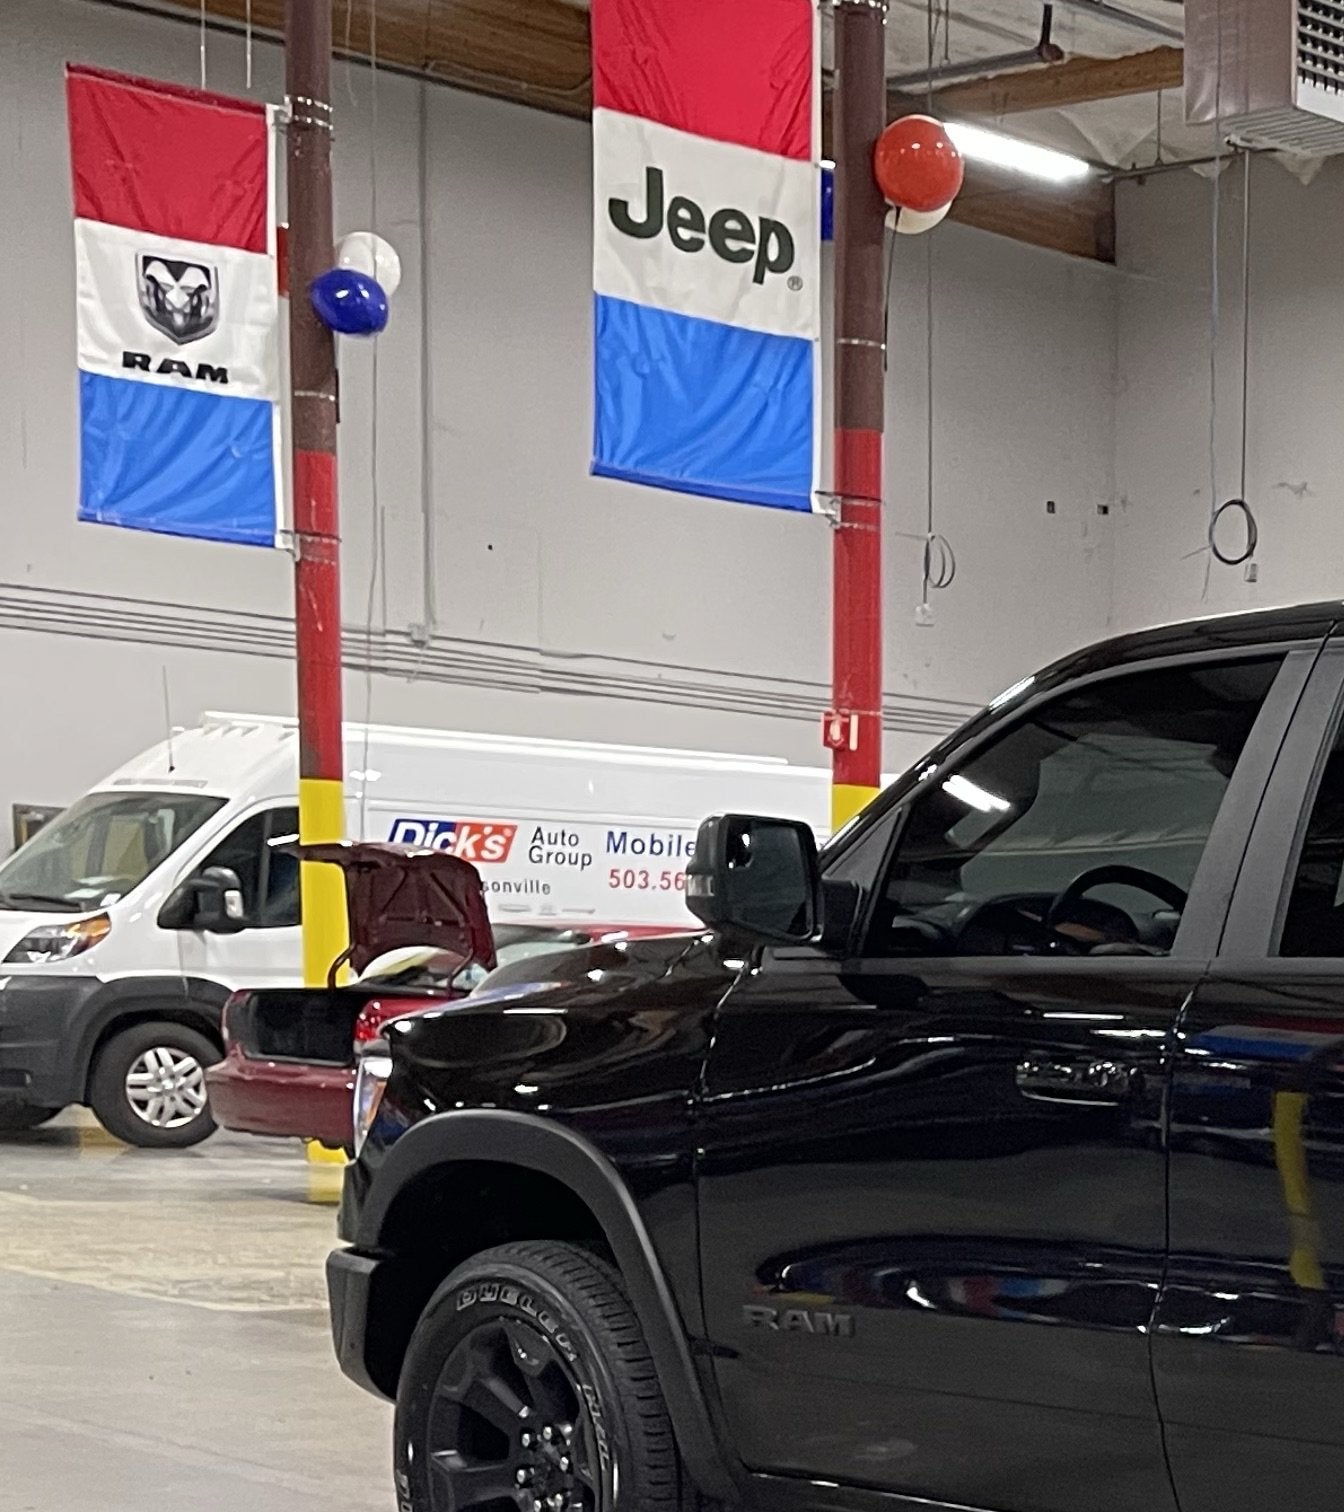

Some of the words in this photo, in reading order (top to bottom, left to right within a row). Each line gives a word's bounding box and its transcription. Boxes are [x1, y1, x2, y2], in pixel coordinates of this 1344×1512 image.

[608, 166, 795, 285] Jeep
[122, 351, 229, 384] RAM
[394, 822, 507, 860] Dick's
[531, 826, 579, 846] Auto
[606, 830, 697, 857] Mobile
[529, 846, 592, 870] Group
[742, 1305, 856, 1337] RAM
